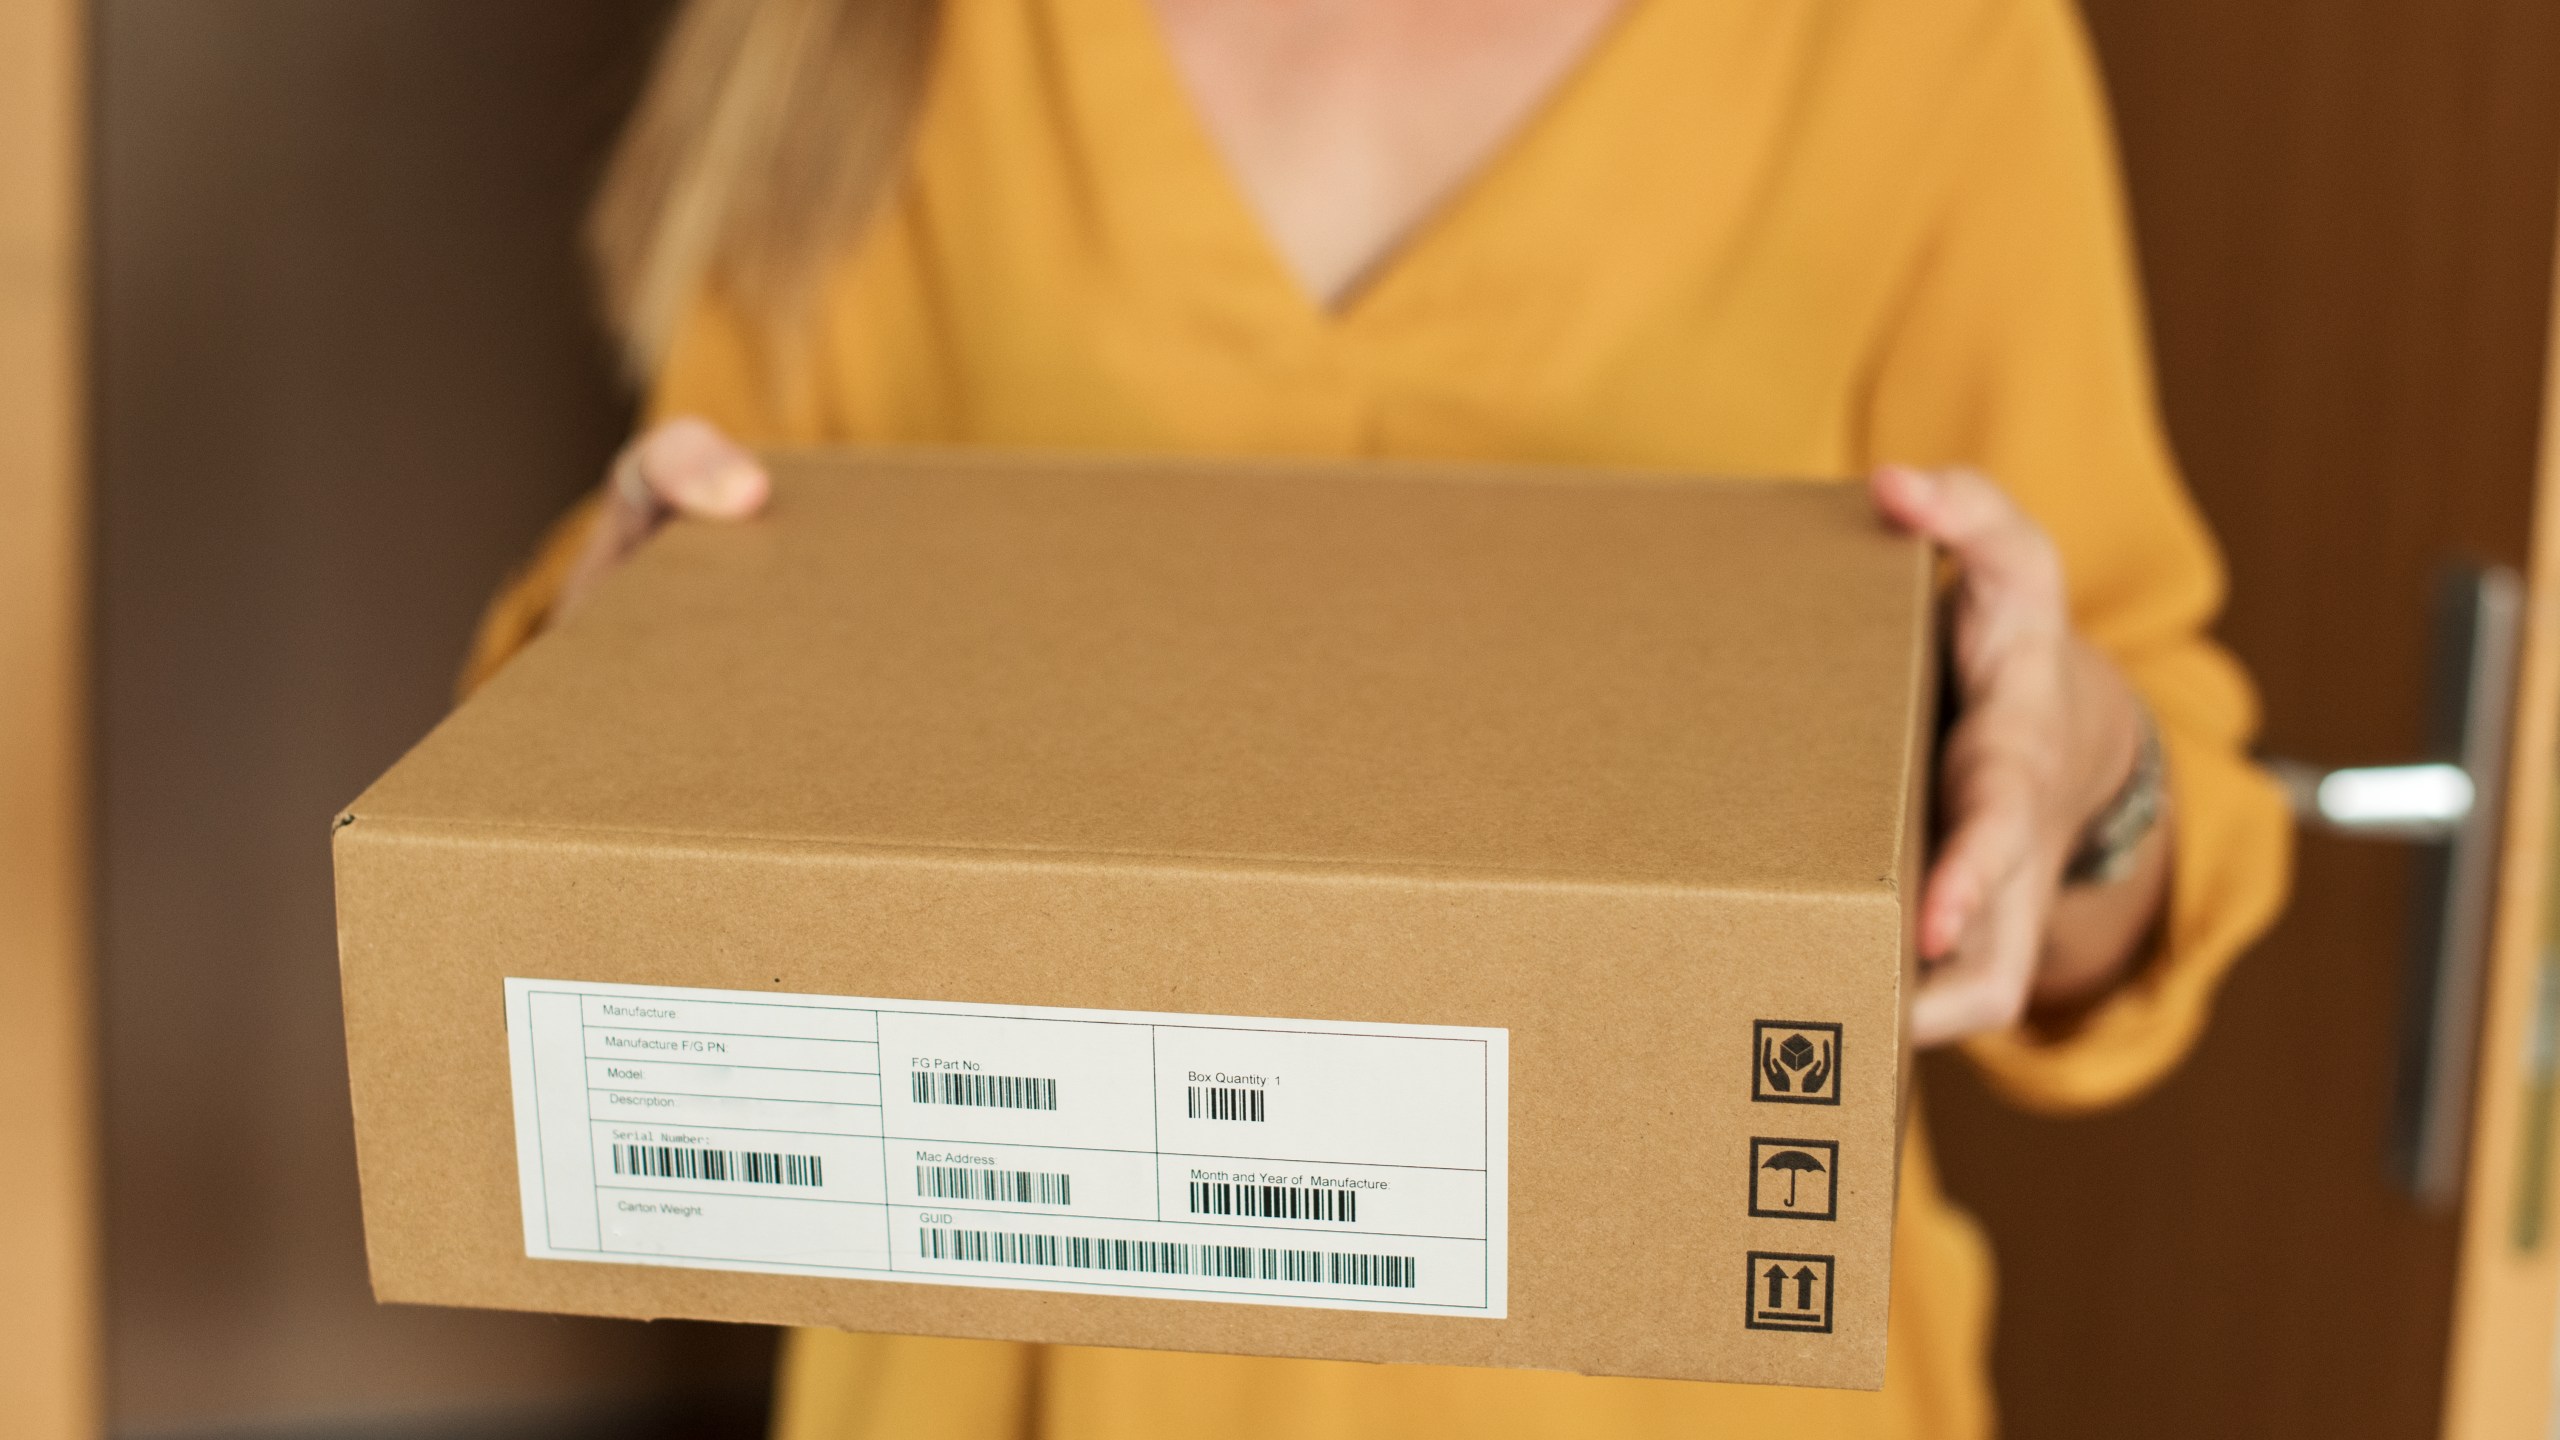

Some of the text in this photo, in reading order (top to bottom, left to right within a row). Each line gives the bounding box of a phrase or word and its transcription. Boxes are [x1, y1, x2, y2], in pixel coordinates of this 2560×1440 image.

[604, 1035, 679, 1051] Manufacture
[681, 1039, 704, 1053] F/G
[911, 1056, 931, 1069] FG
[934, 1058, 959, 1071] Part
[1188, 1070, 1281, 1088] Box Quantity: 1
[611, 1128, 710, 1145] Serial Number:
[916, 1150, 942, 1163] Mac
[1190, 1168, 1392, 1190] Month and Year of Manufacture:
[617, 1199, 657, 1214] Carton
